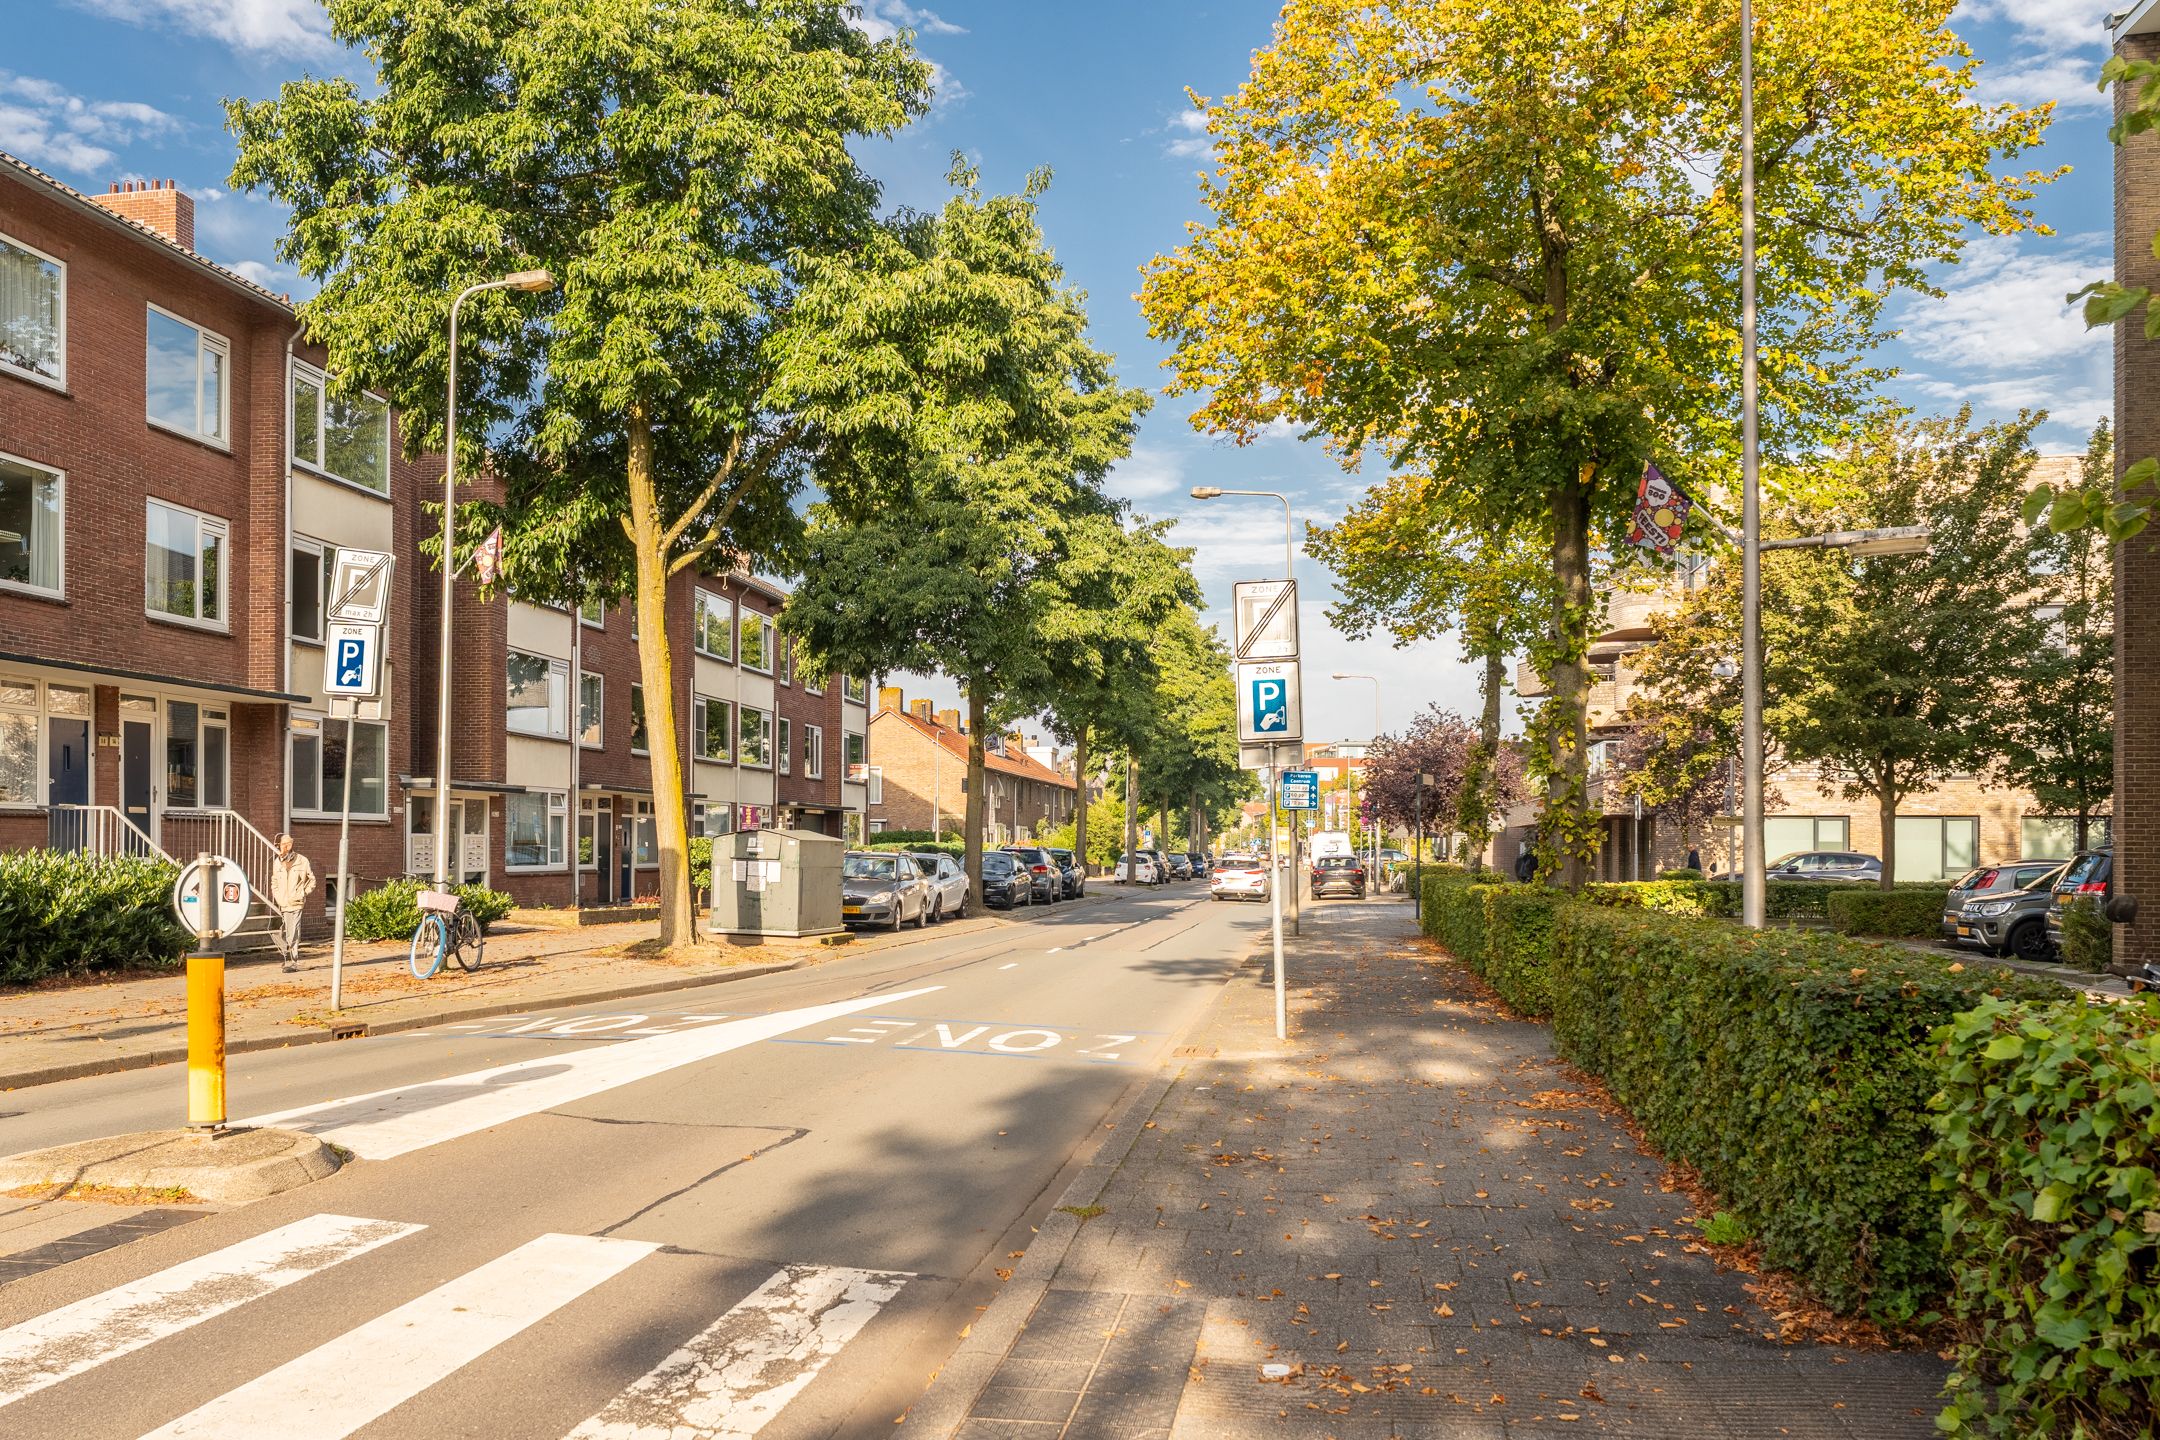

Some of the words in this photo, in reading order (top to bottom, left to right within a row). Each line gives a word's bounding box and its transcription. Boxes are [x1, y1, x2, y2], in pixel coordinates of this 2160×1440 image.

[351, 554, 375, 564] ZONE
[1251, 585, 1279, 593] ZONE
[345, 609, 361, 617] max
[363, 610, 373, 618] 2h
[342, 627, 363, 635] ZONE
[342, 641, 360, 667] P
[1255, 666, 1281, 675] ZONE
[1258, 682, 1280, 711] P
[823, 1019, 1137, 1060] ZONE
